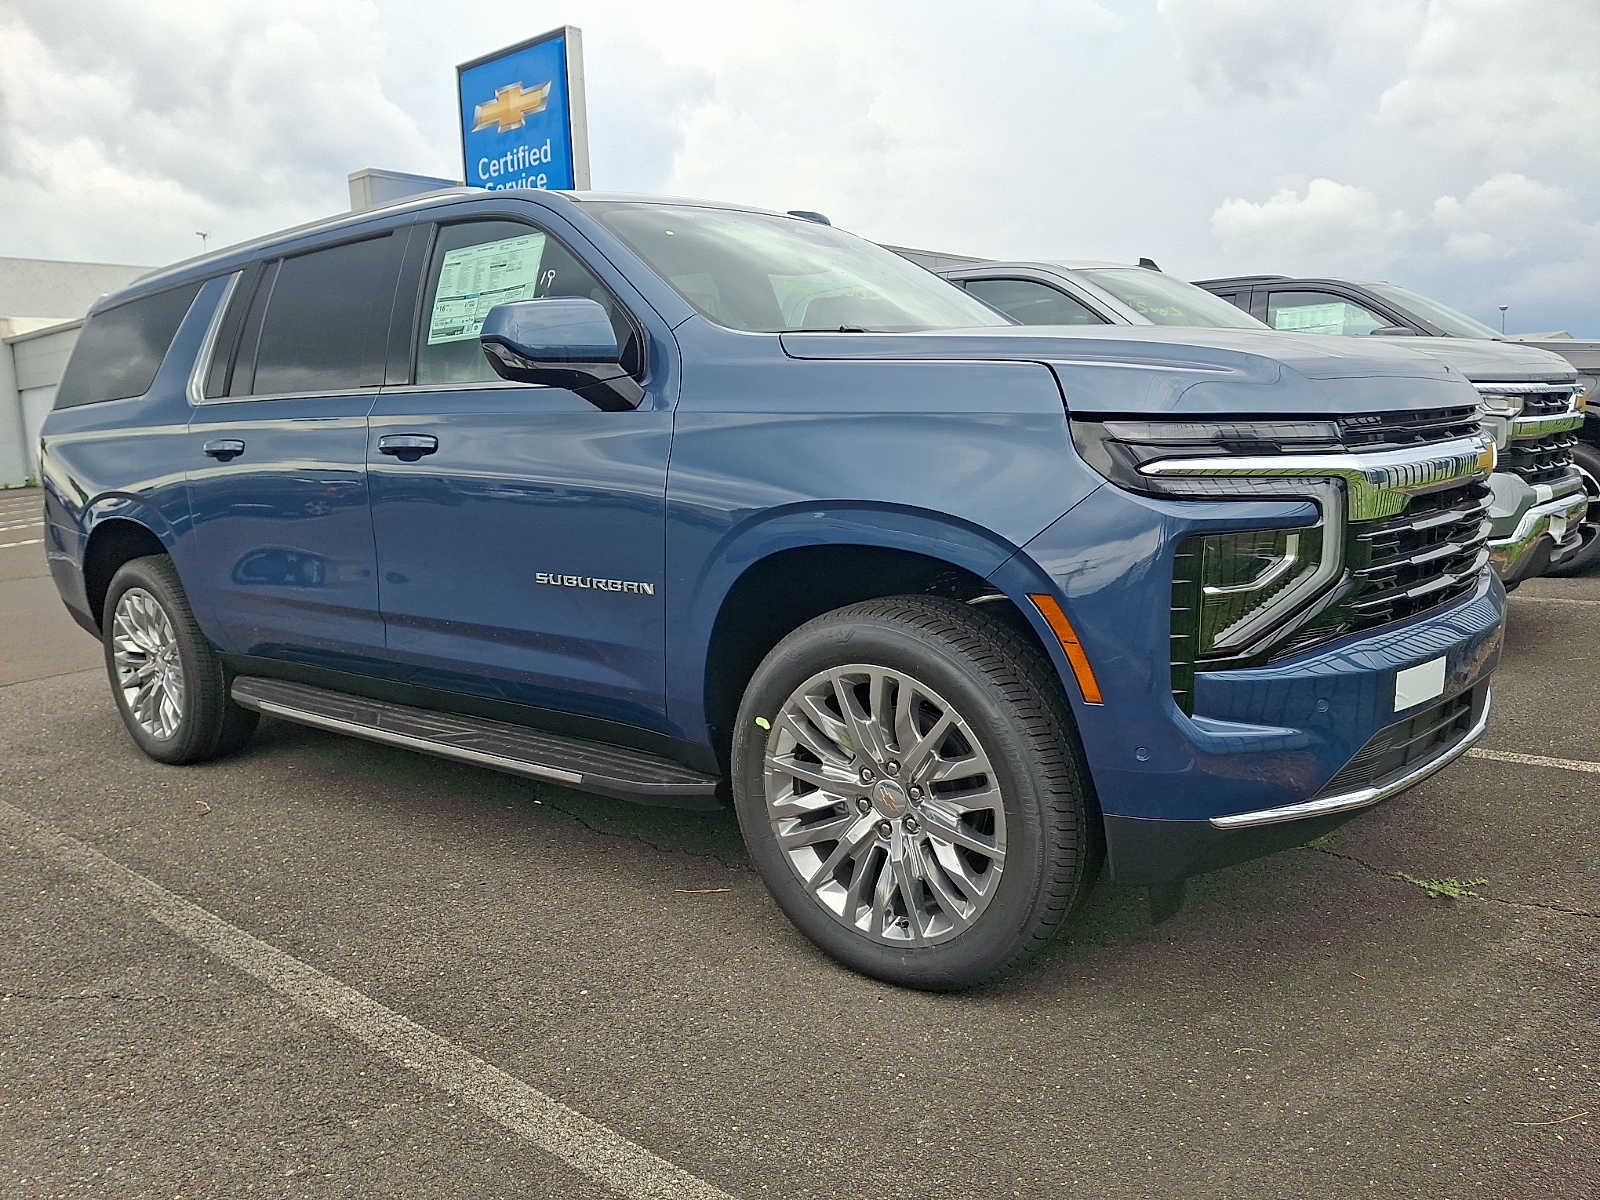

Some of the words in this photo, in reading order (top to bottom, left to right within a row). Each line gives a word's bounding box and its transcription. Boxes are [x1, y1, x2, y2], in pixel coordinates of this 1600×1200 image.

[478, 139, 551, 179] Certified
[540, 269, 556, 289] 19
[535, 572, 655, 596] SUBURBAN
